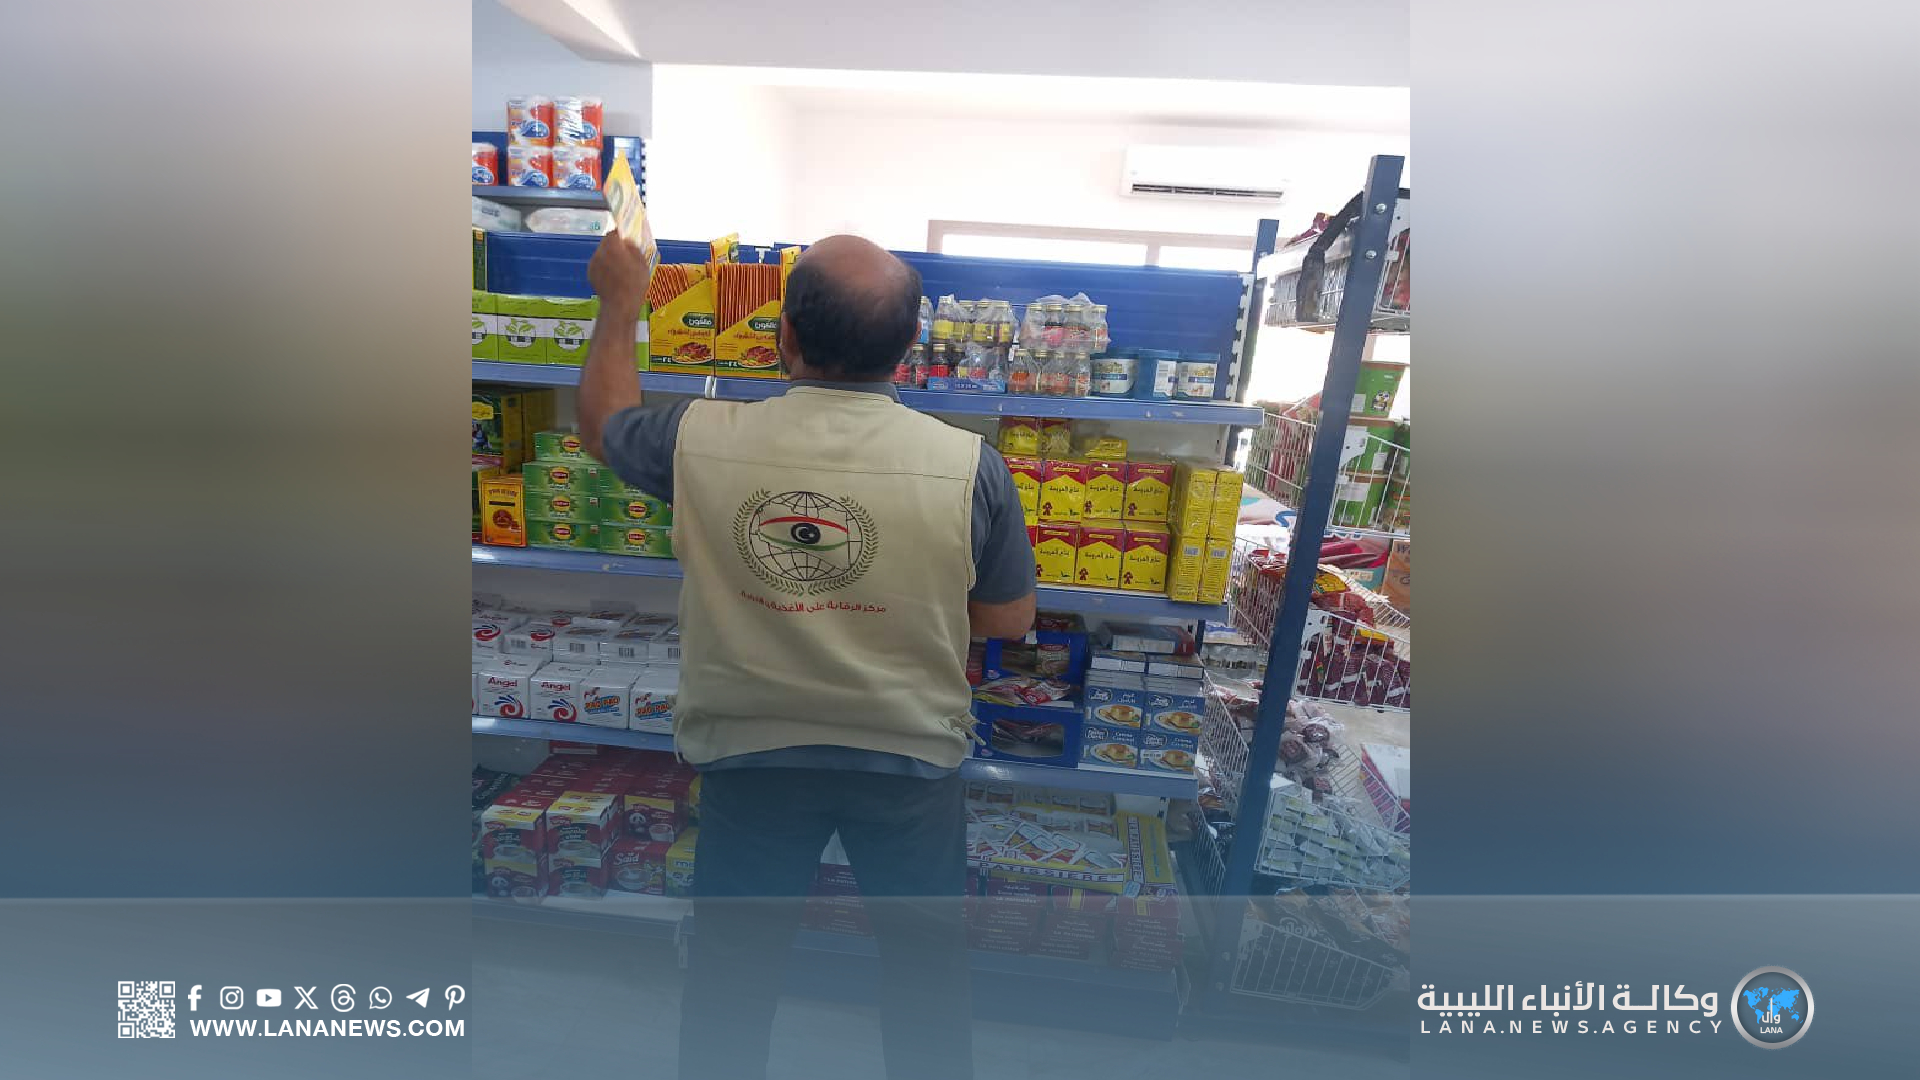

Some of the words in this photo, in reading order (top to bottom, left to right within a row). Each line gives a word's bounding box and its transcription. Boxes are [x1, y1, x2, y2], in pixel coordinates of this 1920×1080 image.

[806, 602, 825, 613] على
[828, 600, 861, 612] الرقابة
[863, 602, 887, 613] مركز
[488, 676, 518, 688] Angel
[540, 681, 571, 691] Angel
